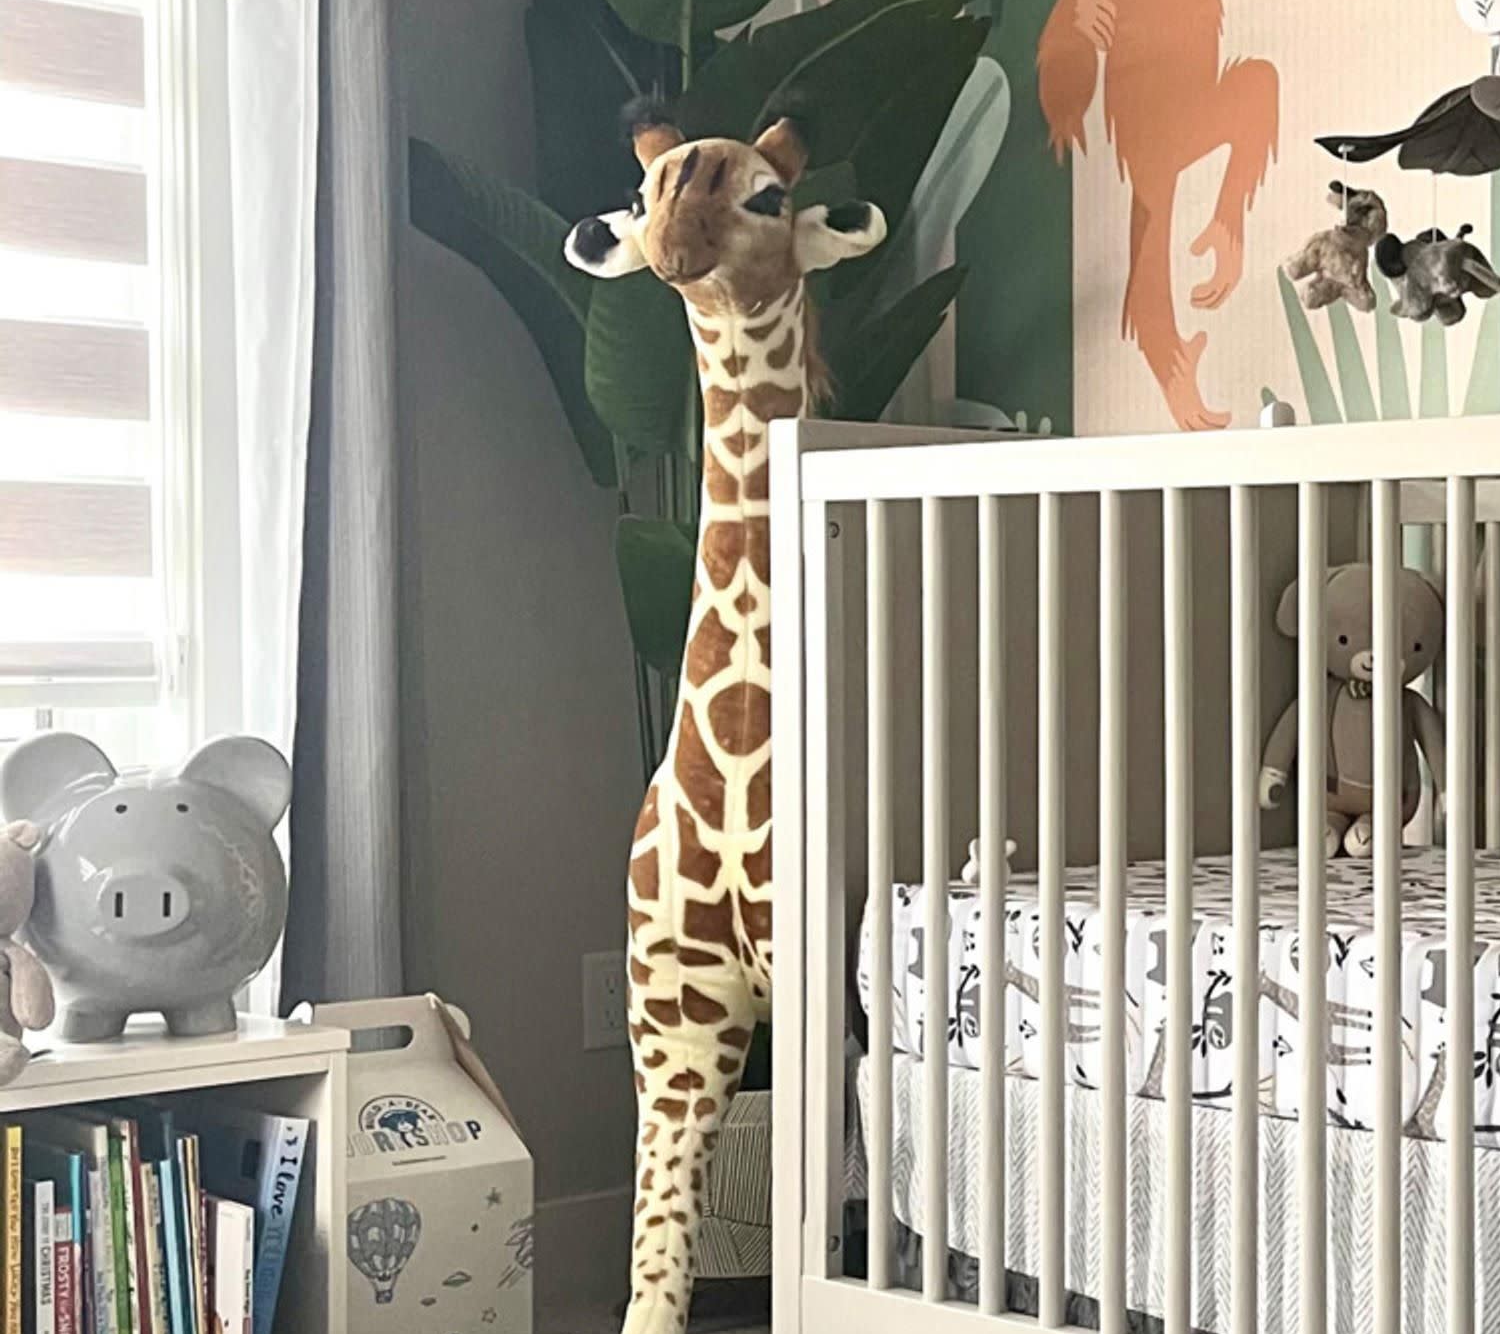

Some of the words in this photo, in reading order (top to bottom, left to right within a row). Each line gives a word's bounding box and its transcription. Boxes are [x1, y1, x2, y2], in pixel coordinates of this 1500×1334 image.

[279, 1155, 299, 1166] I
[271, 1171, 295, 1219] love
[40, 1246, 52, 1306] CHRISTMAS
[57, 1245, 71, 1298] FROSTY
